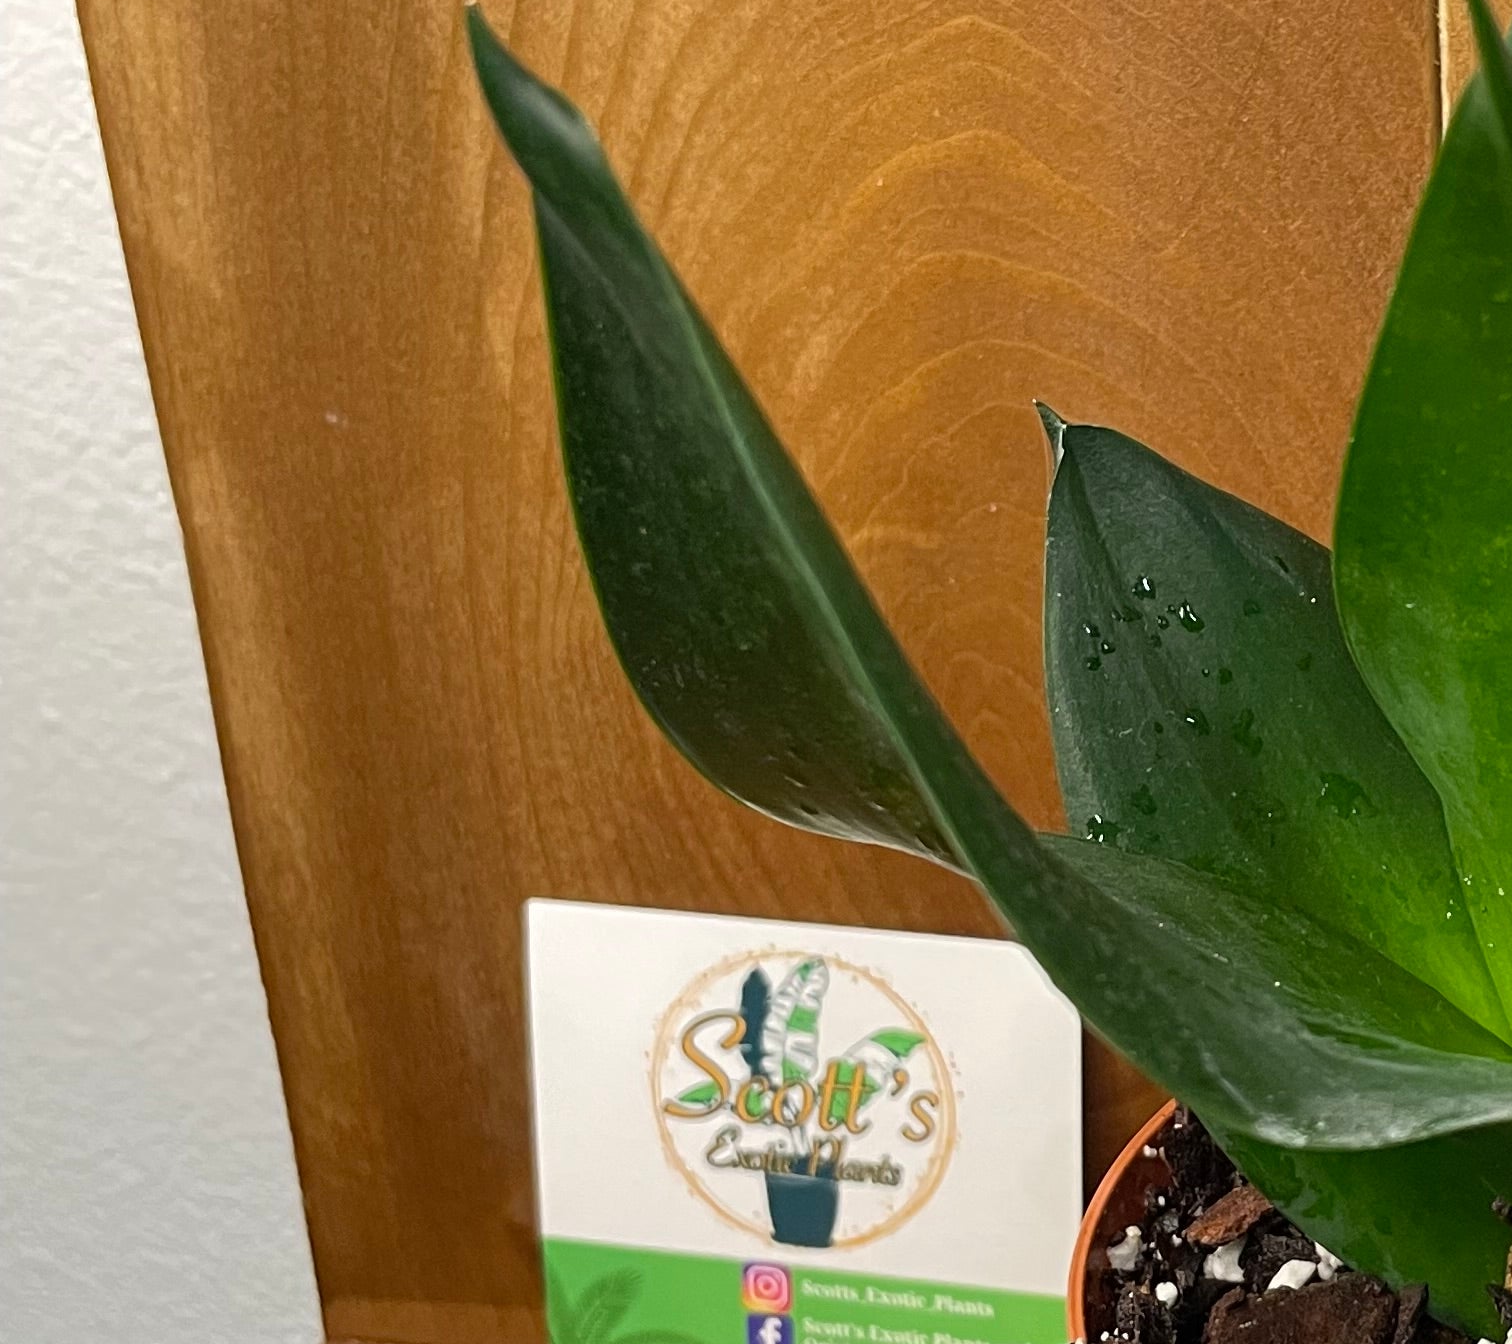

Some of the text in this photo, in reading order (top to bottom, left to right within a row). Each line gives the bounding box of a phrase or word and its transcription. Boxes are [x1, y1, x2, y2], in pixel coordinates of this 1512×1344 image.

[663, 1011, 940, 1142] Scott's
[706, 1125, 902, 1186] Exotic Plants
